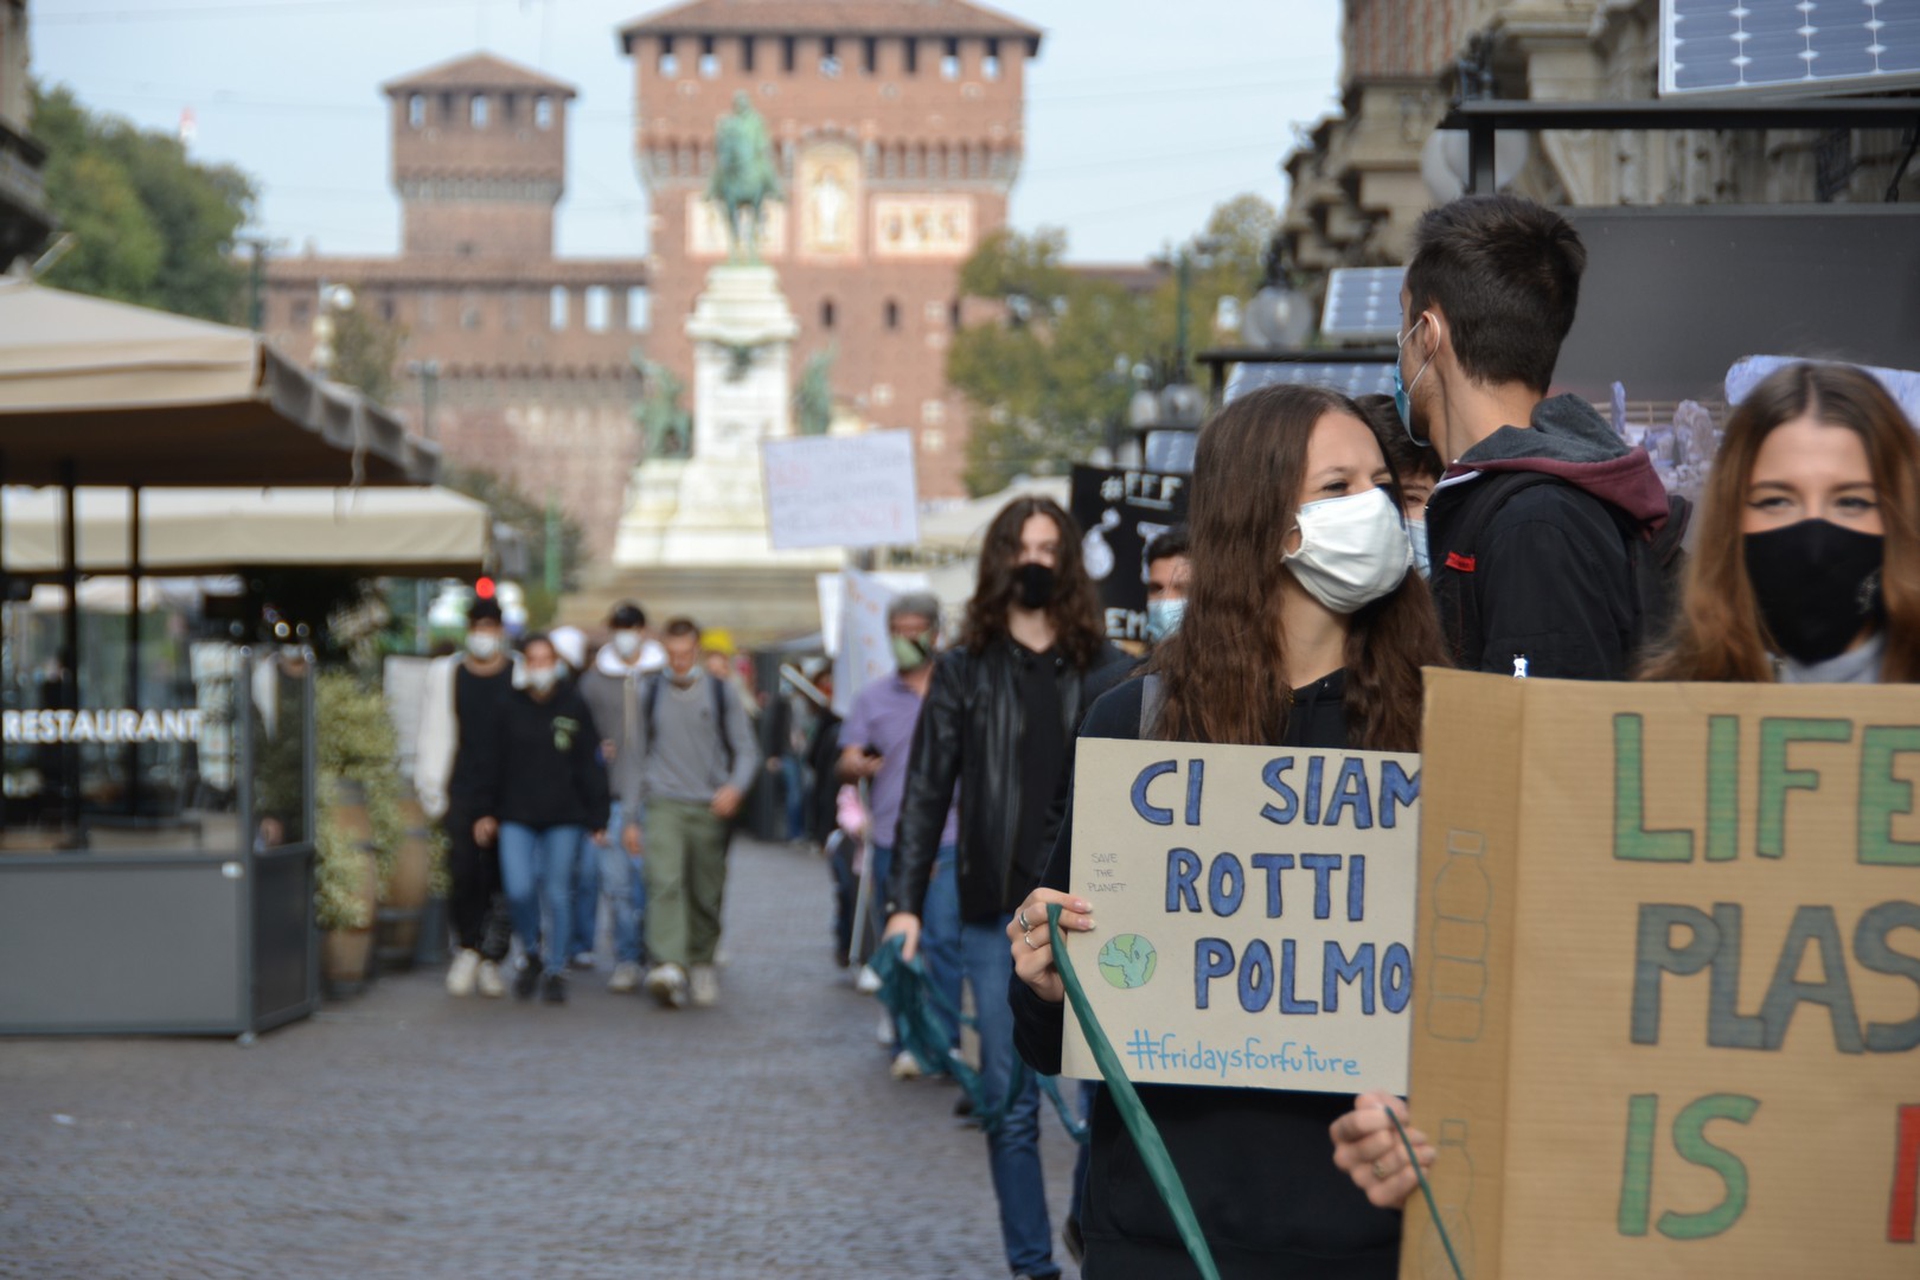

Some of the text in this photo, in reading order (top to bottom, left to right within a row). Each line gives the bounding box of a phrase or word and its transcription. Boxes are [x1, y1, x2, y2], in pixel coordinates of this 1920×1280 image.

[2, 709, 204, 743] RESTAURANT
[1130, 756, 1420, 829] CI SIAM
[1612, 712, 1920, 866] LIFE
[1086, 882, 1127, 893] PLANET
[1091, 852, 1118, 864] SAVE
[1093, 868, 1114, 878] THE
[1165, 847, 1365, 922] ROTTI
[1194, 937, 1412, 1016] POLMO
[1630, 901, 1920, 1054] PLAS
[1126, 1029, 1361, 1078] #fridaysforfuture
[1617, 1092, 1761, 1240] IS
